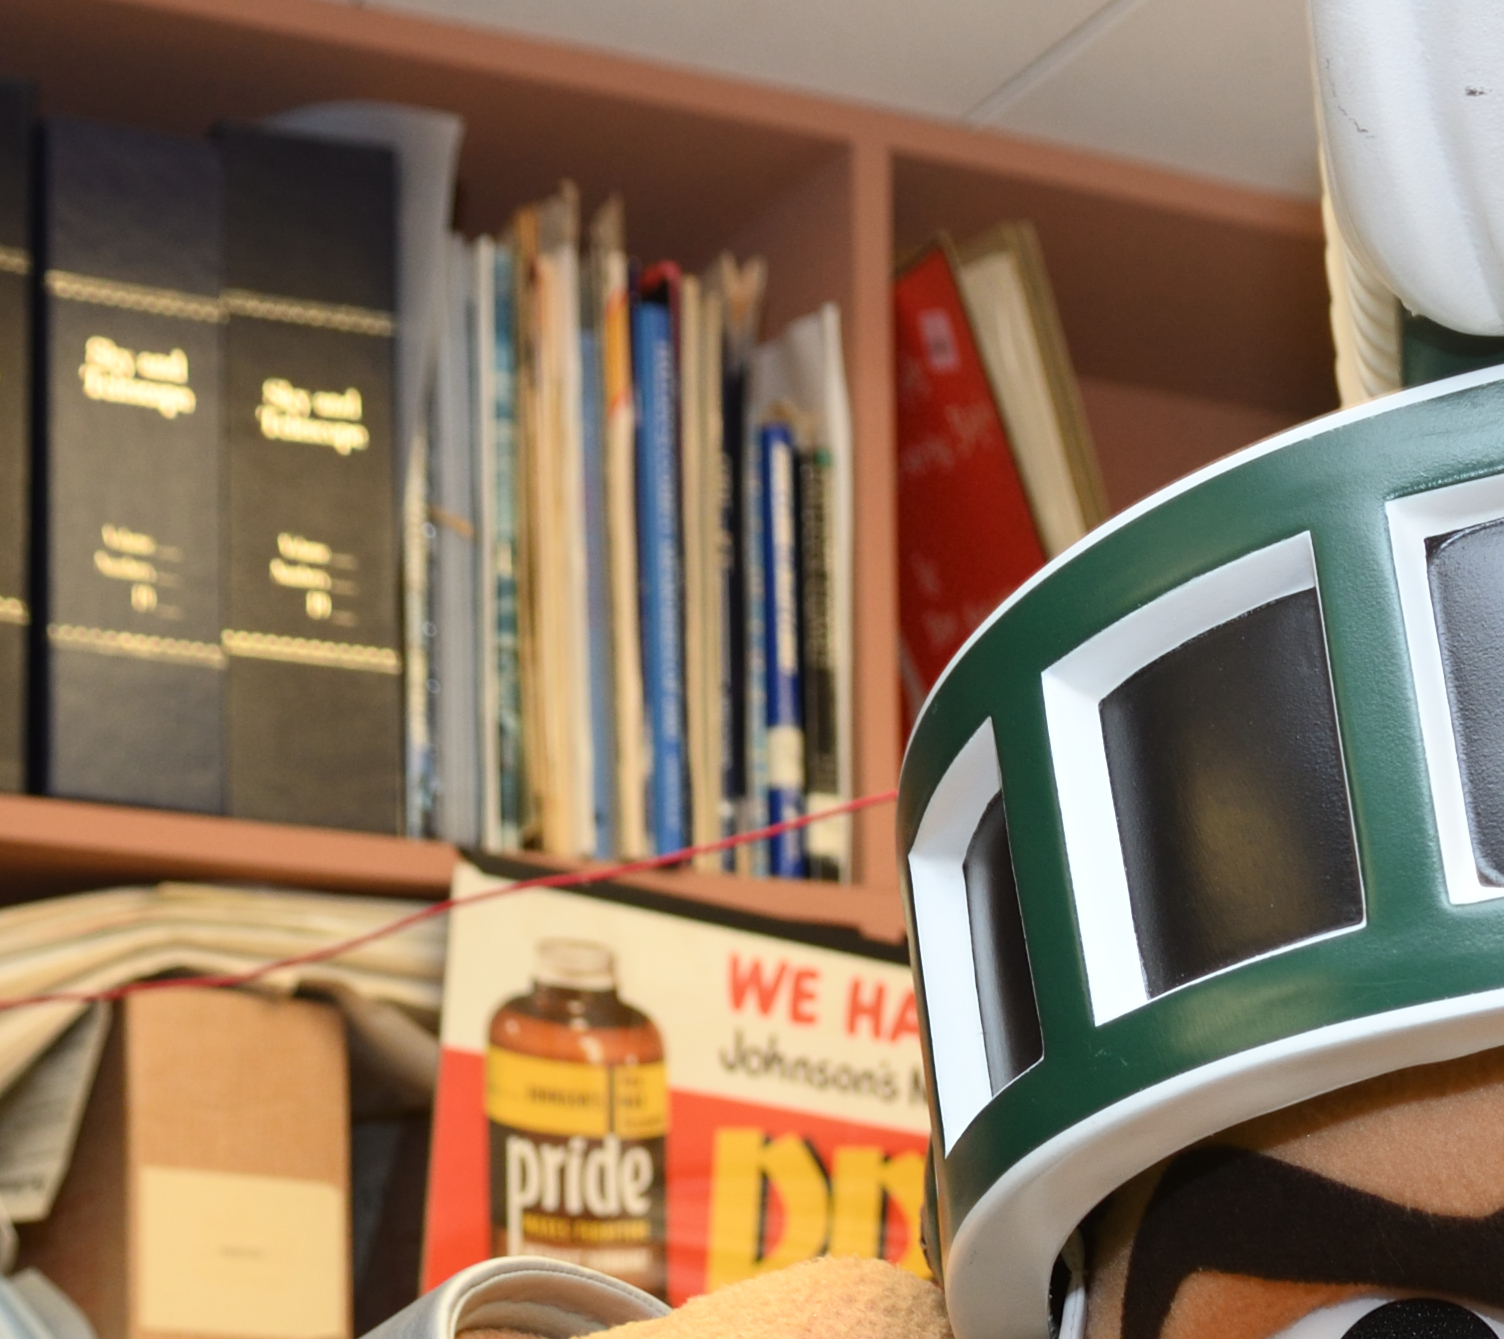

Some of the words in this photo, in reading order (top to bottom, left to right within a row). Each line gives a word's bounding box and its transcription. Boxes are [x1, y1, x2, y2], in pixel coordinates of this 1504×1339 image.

[727, 951, 821, 1027] WE
[717, 1026, 899, 1099] Johnson's
[506, 1132, 654, 1257] pride
